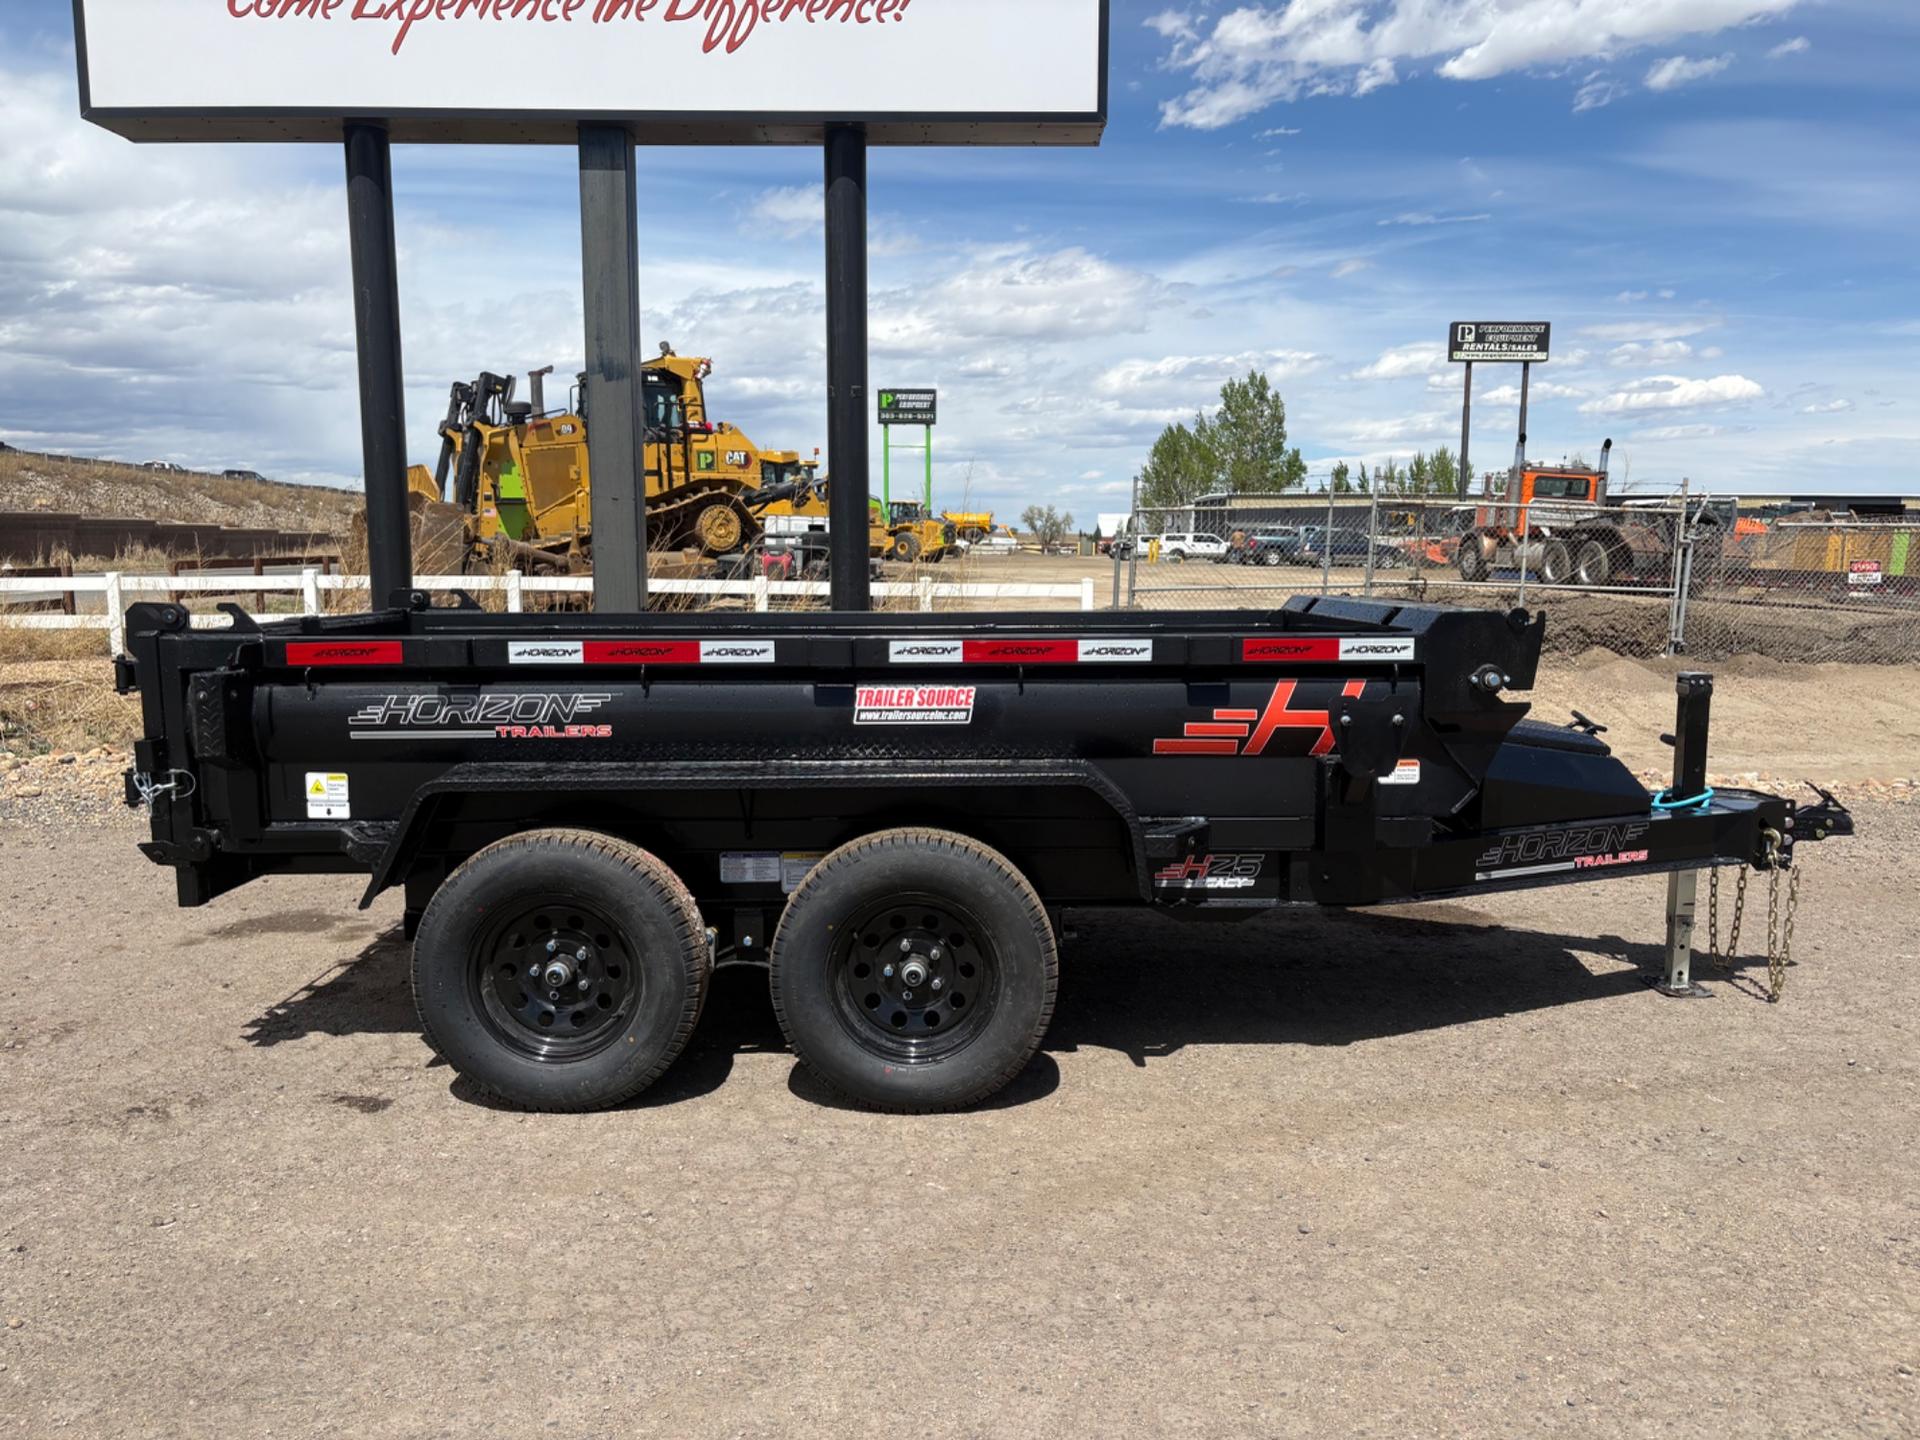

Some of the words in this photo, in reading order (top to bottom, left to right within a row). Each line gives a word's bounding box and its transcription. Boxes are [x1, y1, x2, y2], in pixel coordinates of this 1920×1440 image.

[1479, 325, 1545, 333] PERFORMANCE
[1485, 334, 1537, 342] EQUIPMENT
[1462, 343, 1537, 351] RENTALS/SALES
[725, 451, 747, 465] CAT
[517, 648, 578, 657] HORIZON
[611, 648, 669, 656] HORIZON
[706, 648, 766, 656] HORIZON
[897, 647, 957, 655] HORIZON
[991, 647, 1051, 655] HORIZON
[1086, 647, 1146, 655] HORIZON
[1346, 645, 1407, 654] HORIZON
[857, 688, 915, 707] TRAILER
[917, 688, 974, 707] SOURCE
[365, 694, 595, 725] HORIZON
[496, 725, 612, 737] TRAILERS
[1489, 824, 1638, 864] HORIZON
[1575, 850, 1648, 868] TRAILERS
